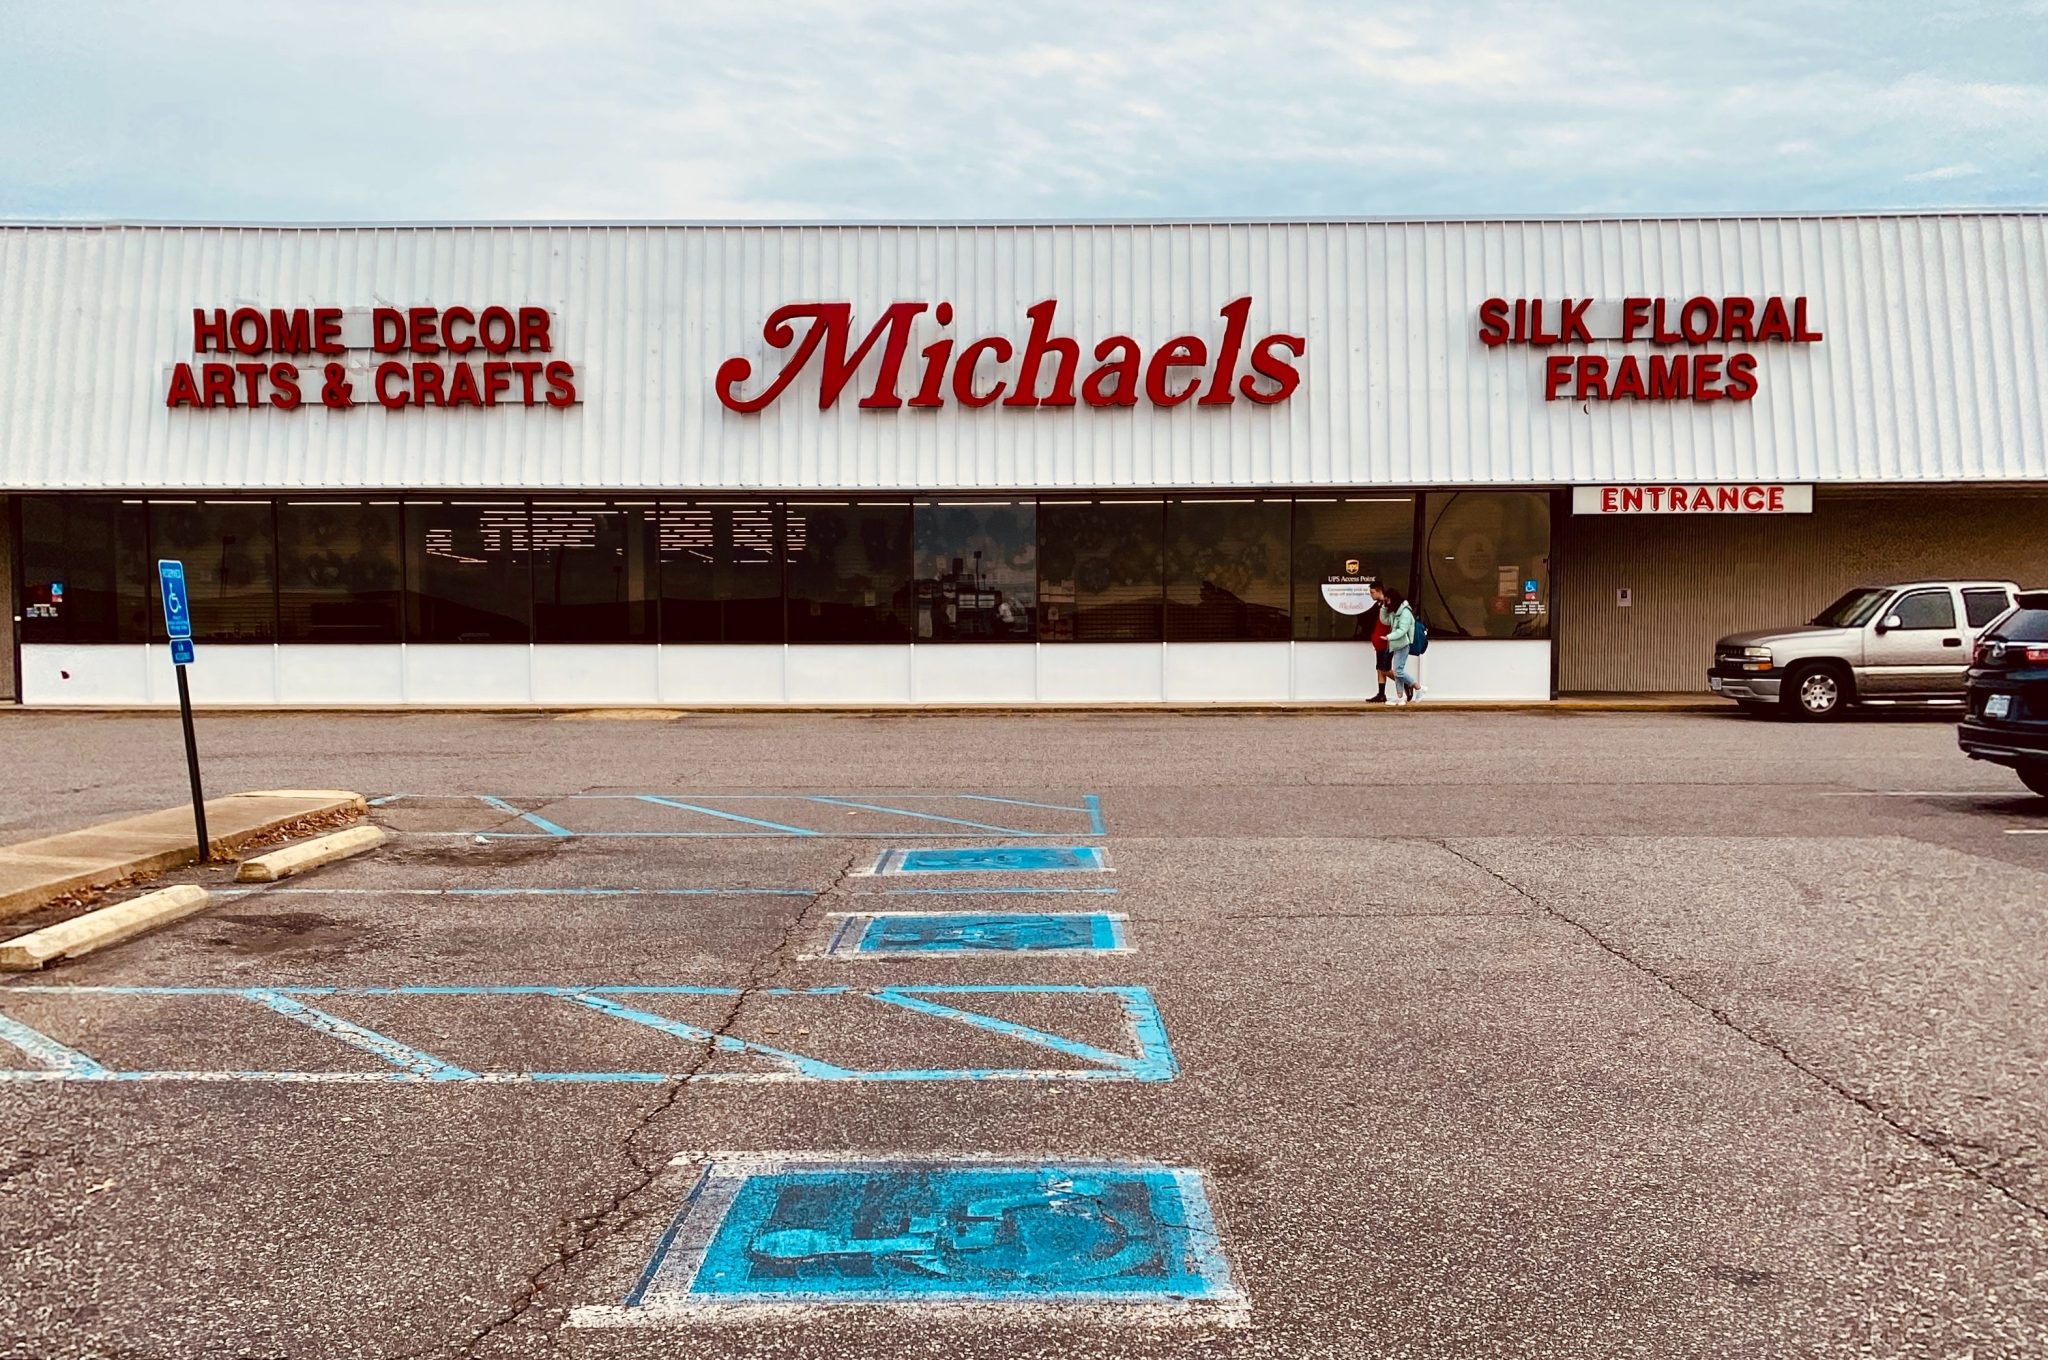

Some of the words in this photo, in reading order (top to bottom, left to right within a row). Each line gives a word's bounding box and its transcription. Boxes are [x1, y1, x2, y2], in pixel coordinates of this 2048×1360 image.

[193, 307, 346, 354] HOME
[373, 305, 553, 354] DECOR
[1479, 298, 1594, 347] SILK
[1623, 296, 1823, 346] FLORAL
[715, 296, 1306, 415] Michaels
[1545, 353, 1758, 401] FRAMES
[166, 362, 302, 410] ARTS
[321, 361, 354, 409] &
[375, 360, 577, 410] CRAFTS
[1600, 485, 1785, 513] ENTRANCE
